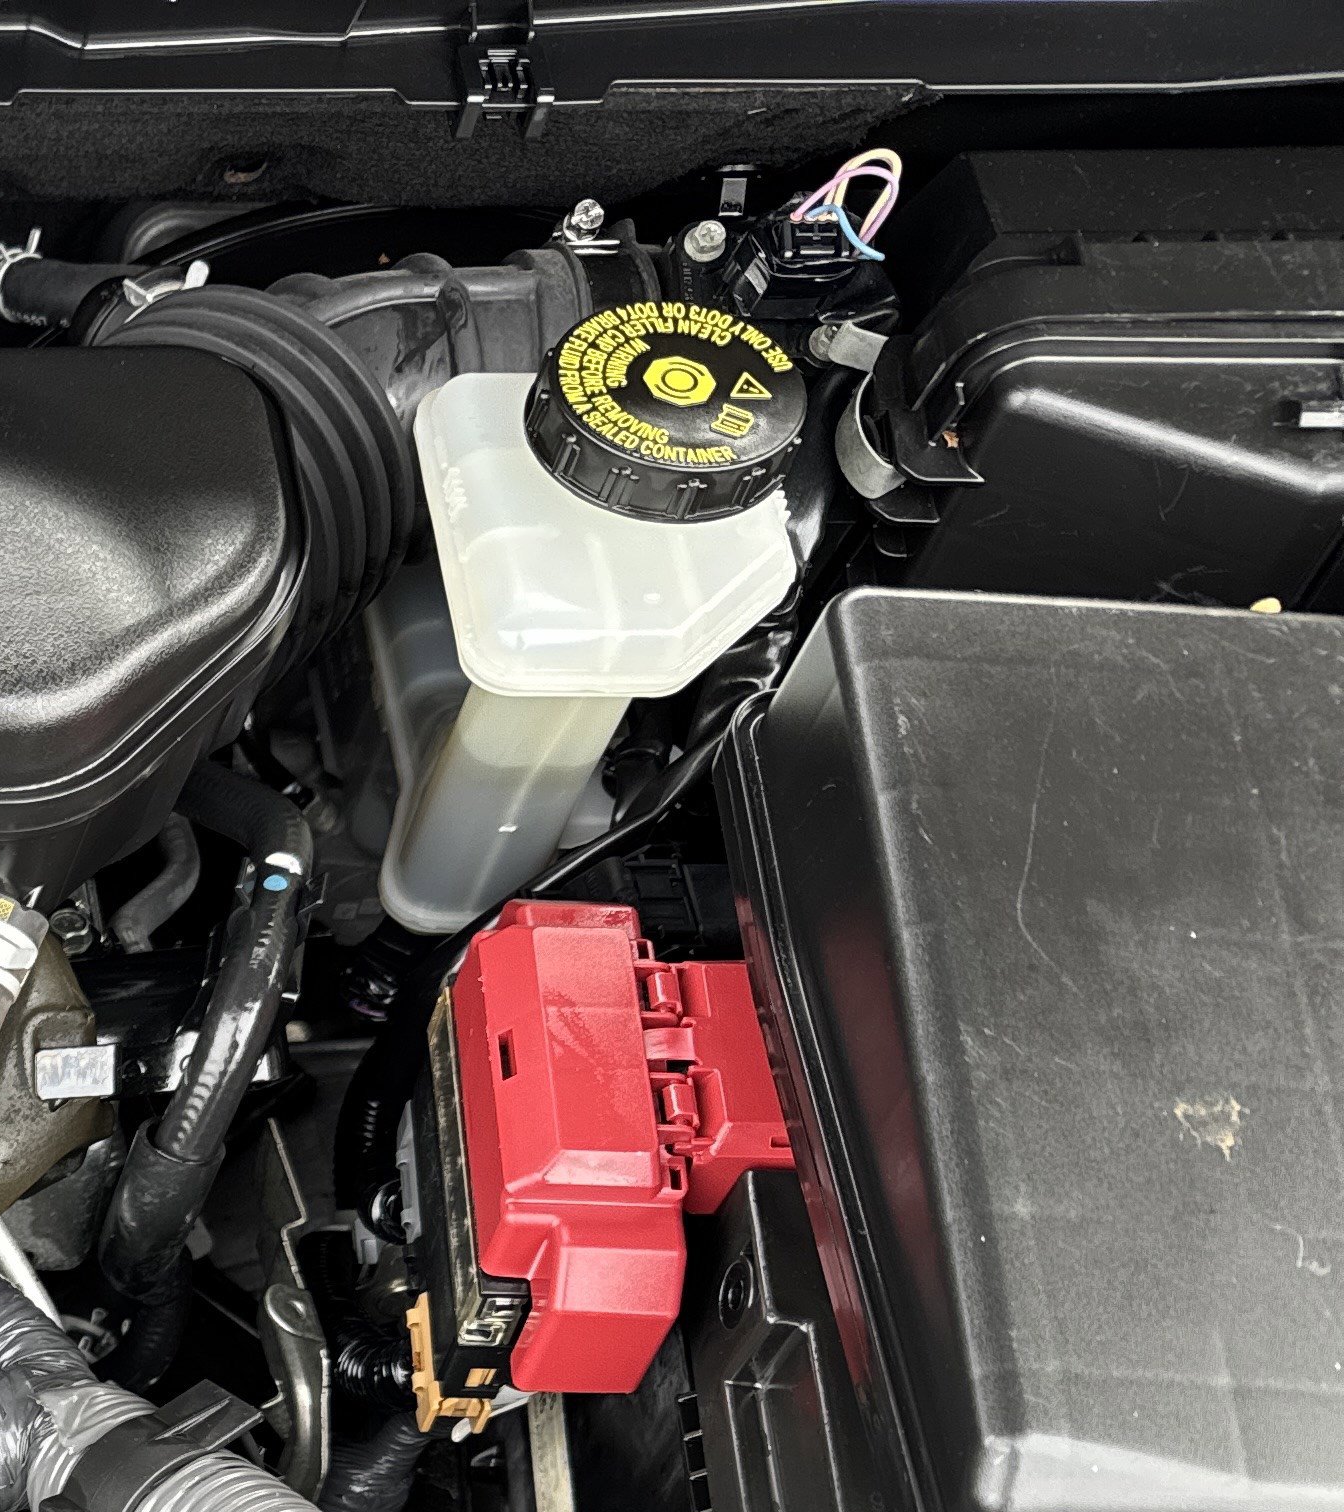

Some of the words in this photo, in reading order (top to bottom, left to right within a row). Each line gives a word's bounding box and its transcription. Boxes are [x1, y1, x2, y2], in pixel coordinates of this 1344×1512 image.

[615, 302, 659, 321] DOT4
[661, 302, 686, 319] OR
[688, 304, 733, 329] DOT3
[573, 310, 620, 343] BRAKE
[595, 329, 626, 353] CAP
[618, 317, 674, 338] FILLER
[677, 318, 732, 347] CLEAN
[728, 321, 773, 351] ONLY
[558, 336, 589, 369] FLUID
[605, 337, 652, 388] WARNING
[761, 346, 794, 373] USE
[581, 348, 609, 395] BEFORE
[558, 369, 589, 404] FROM
[572, 403, 593, 415] A
[591, 394, 670, 444] REMOVING
[582, 410, 640, 449] SEALED
[640, 440, 738, 463] CONTAINER
